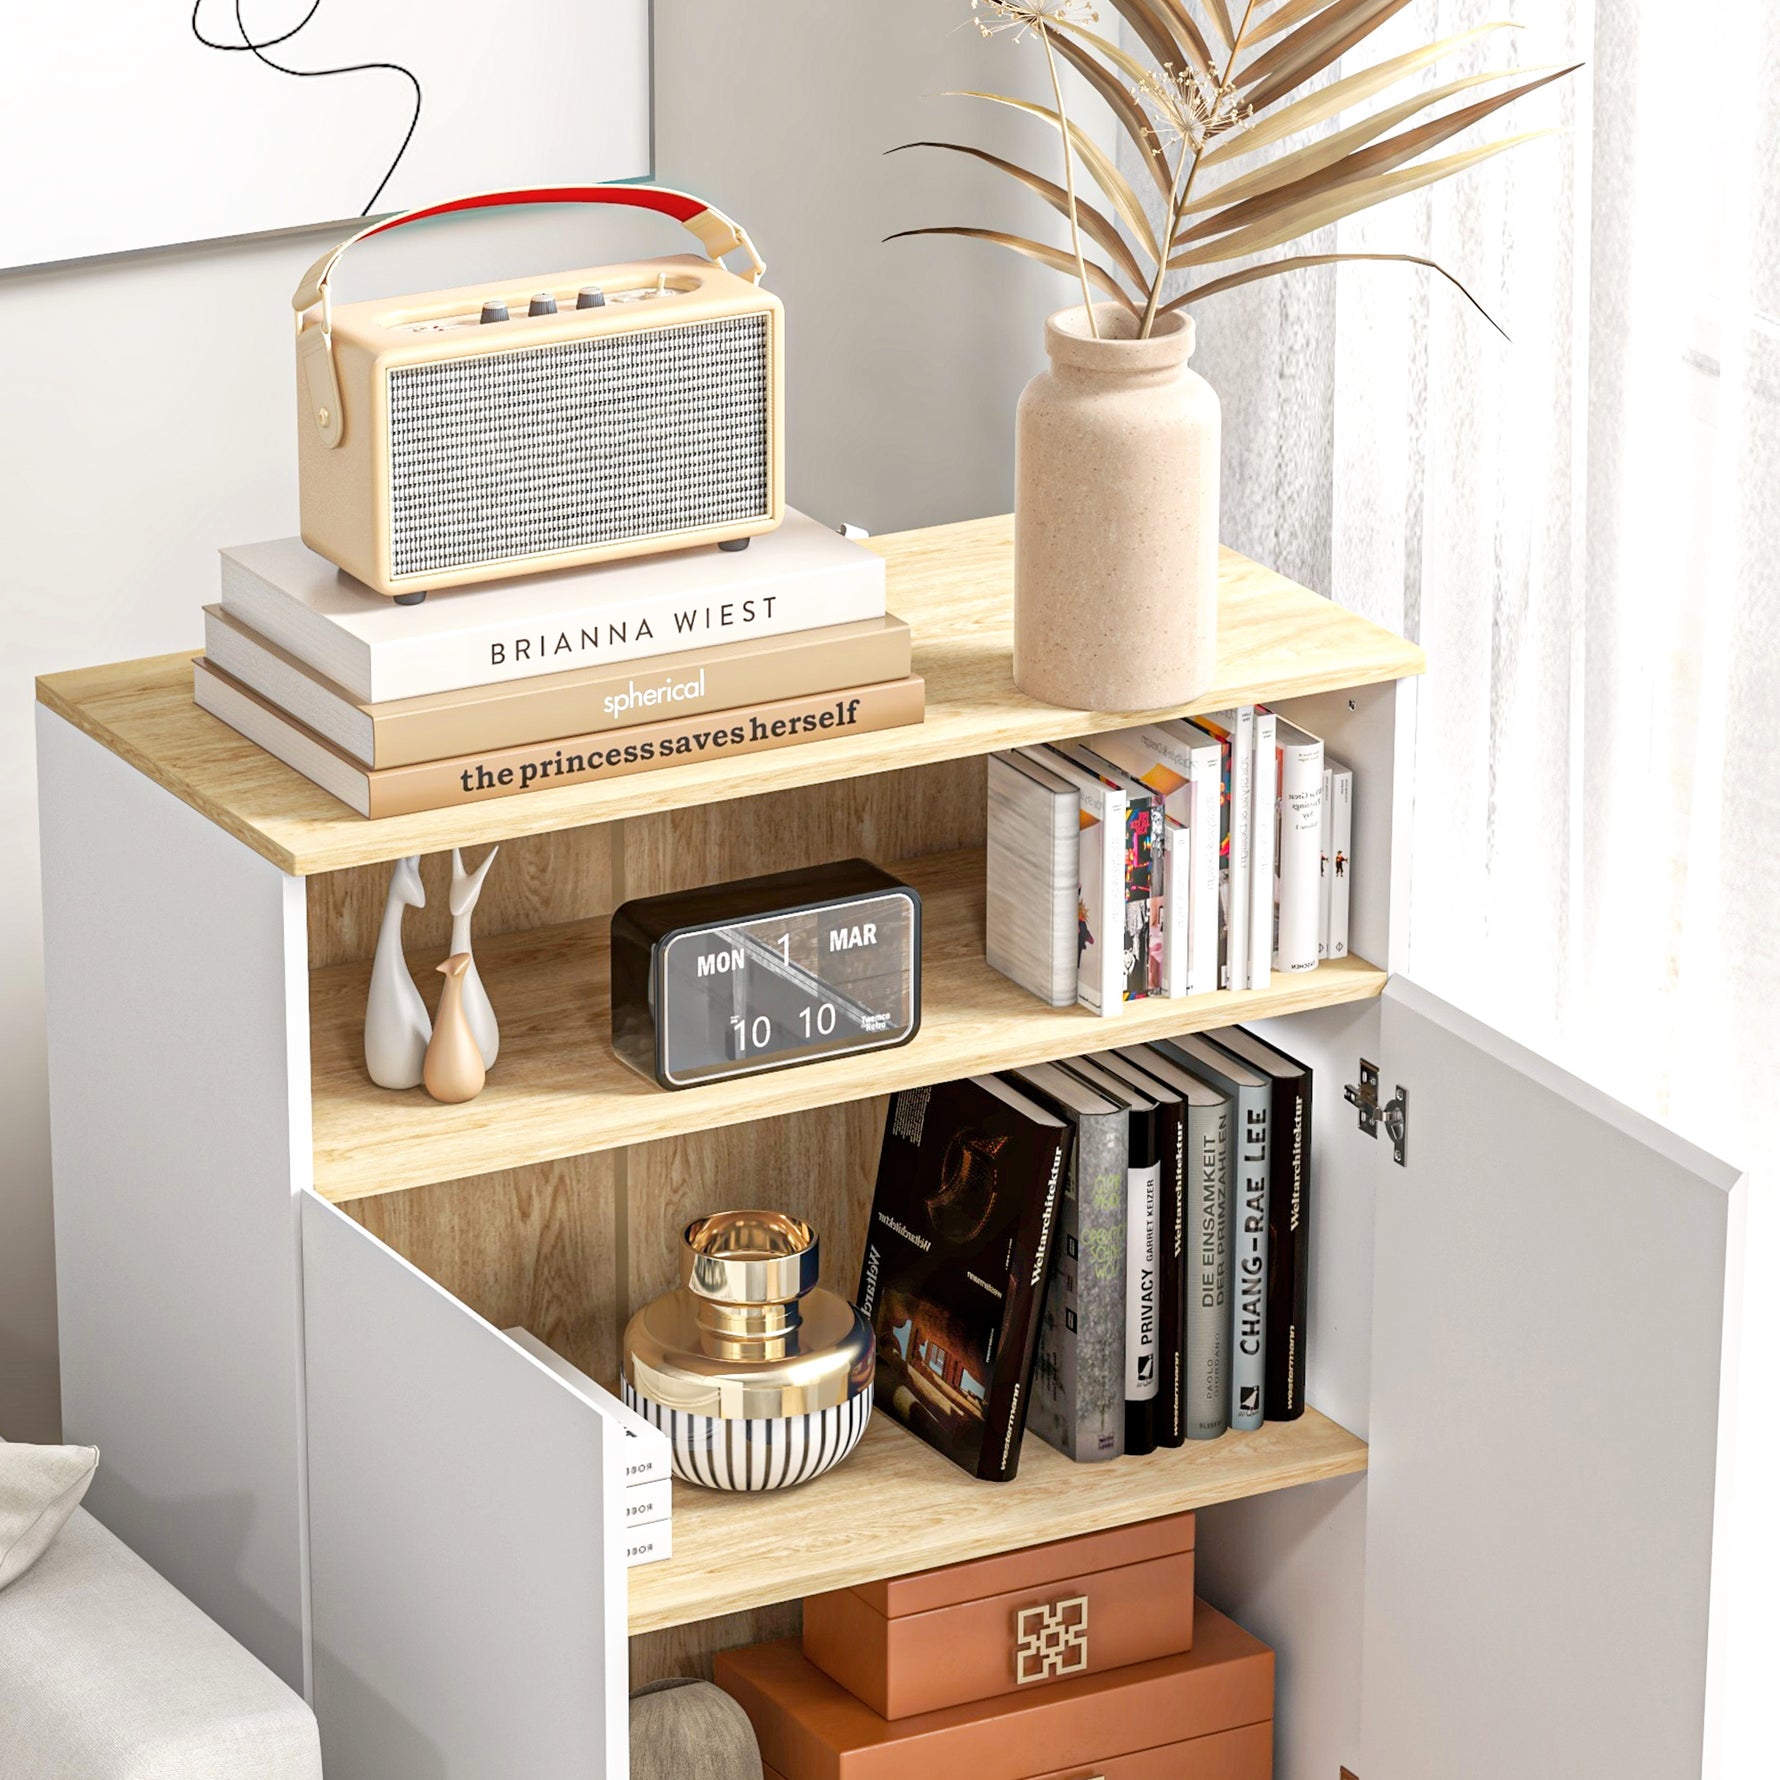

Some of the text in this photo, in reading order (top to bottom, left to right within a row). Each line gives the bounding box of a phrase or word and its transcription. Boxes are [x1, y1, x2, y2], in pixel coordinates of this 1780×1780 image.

[491, 597, 777, 665] BRIANNA WIEST
[460, 699, 861, 792] the princess saves herself
[603, 668, 705, 718] spherical
[697, 923, 877, 977] MON 1 MAR
[734, 1003, 836, 1051] 10 10
[1031, 1146, 1063, 1286] Weltarchitektur
[1174, 1121, 1183, 1258] Weltarchitektur
[1202, 1135, 1216, 1307] DIE EINSAMKEIT
[1216, 1114, 1227, 1306] DER PRIMZAHLEN
[1290, 1095, 1303, 1232] Weltarchitektur
[1140, 1179, 1154, 1345] PRIVACY GARRET KEIZER
[1240, 1109, 1266, 1355] CHANG-RAE LEE
[1287, 1325, 1295, 1410] westermann
[1001, 1383, 1020, 1470] westermann
